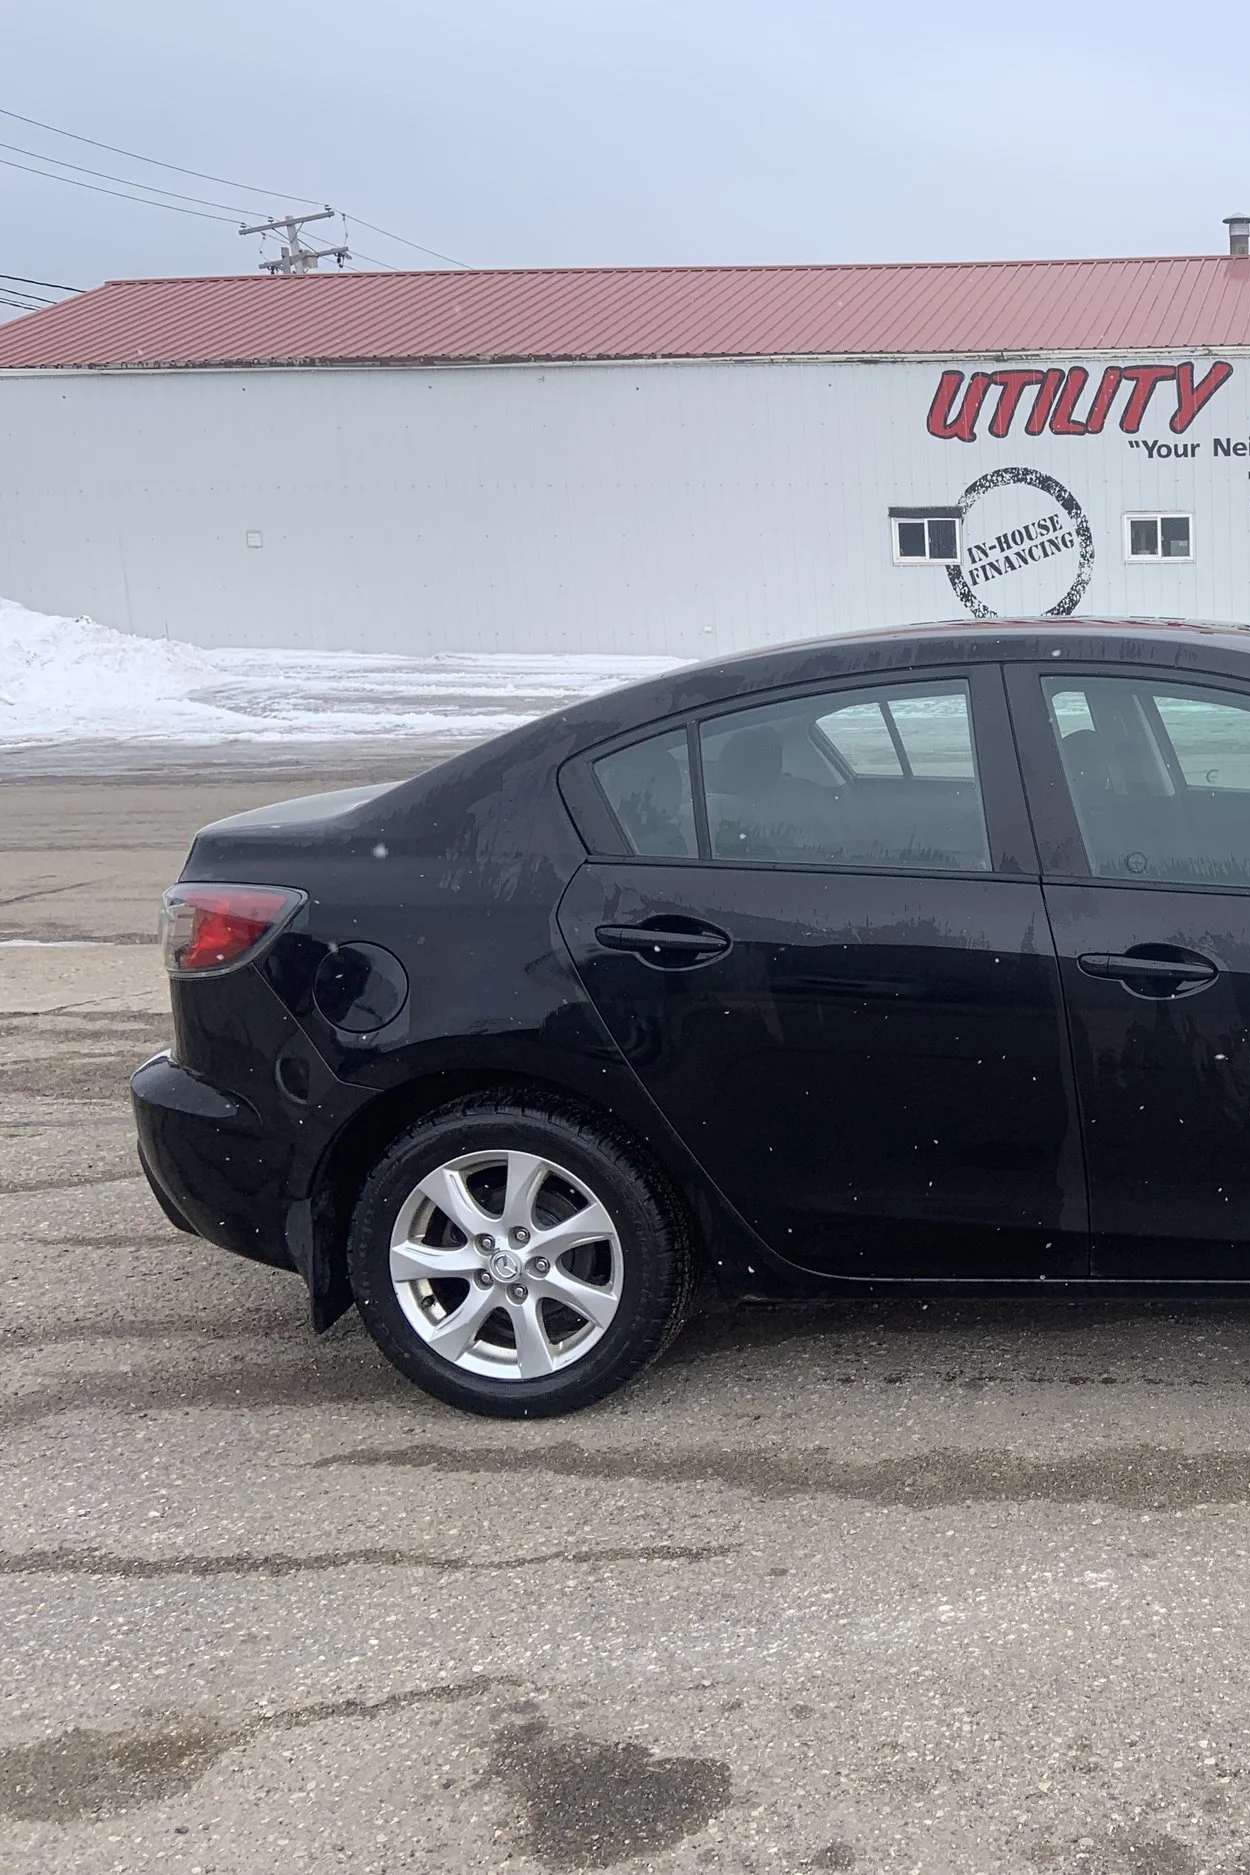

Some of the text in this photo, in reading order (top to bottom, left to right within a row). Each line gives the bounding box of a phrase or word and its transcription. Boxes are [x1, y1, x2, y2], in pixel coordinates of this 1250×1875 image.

[926, 361, 1233, 442] UTILITY
[966, 514, 1063, 564] IN-HOUSE
[968, 531, 1075, 587] FINANCING
